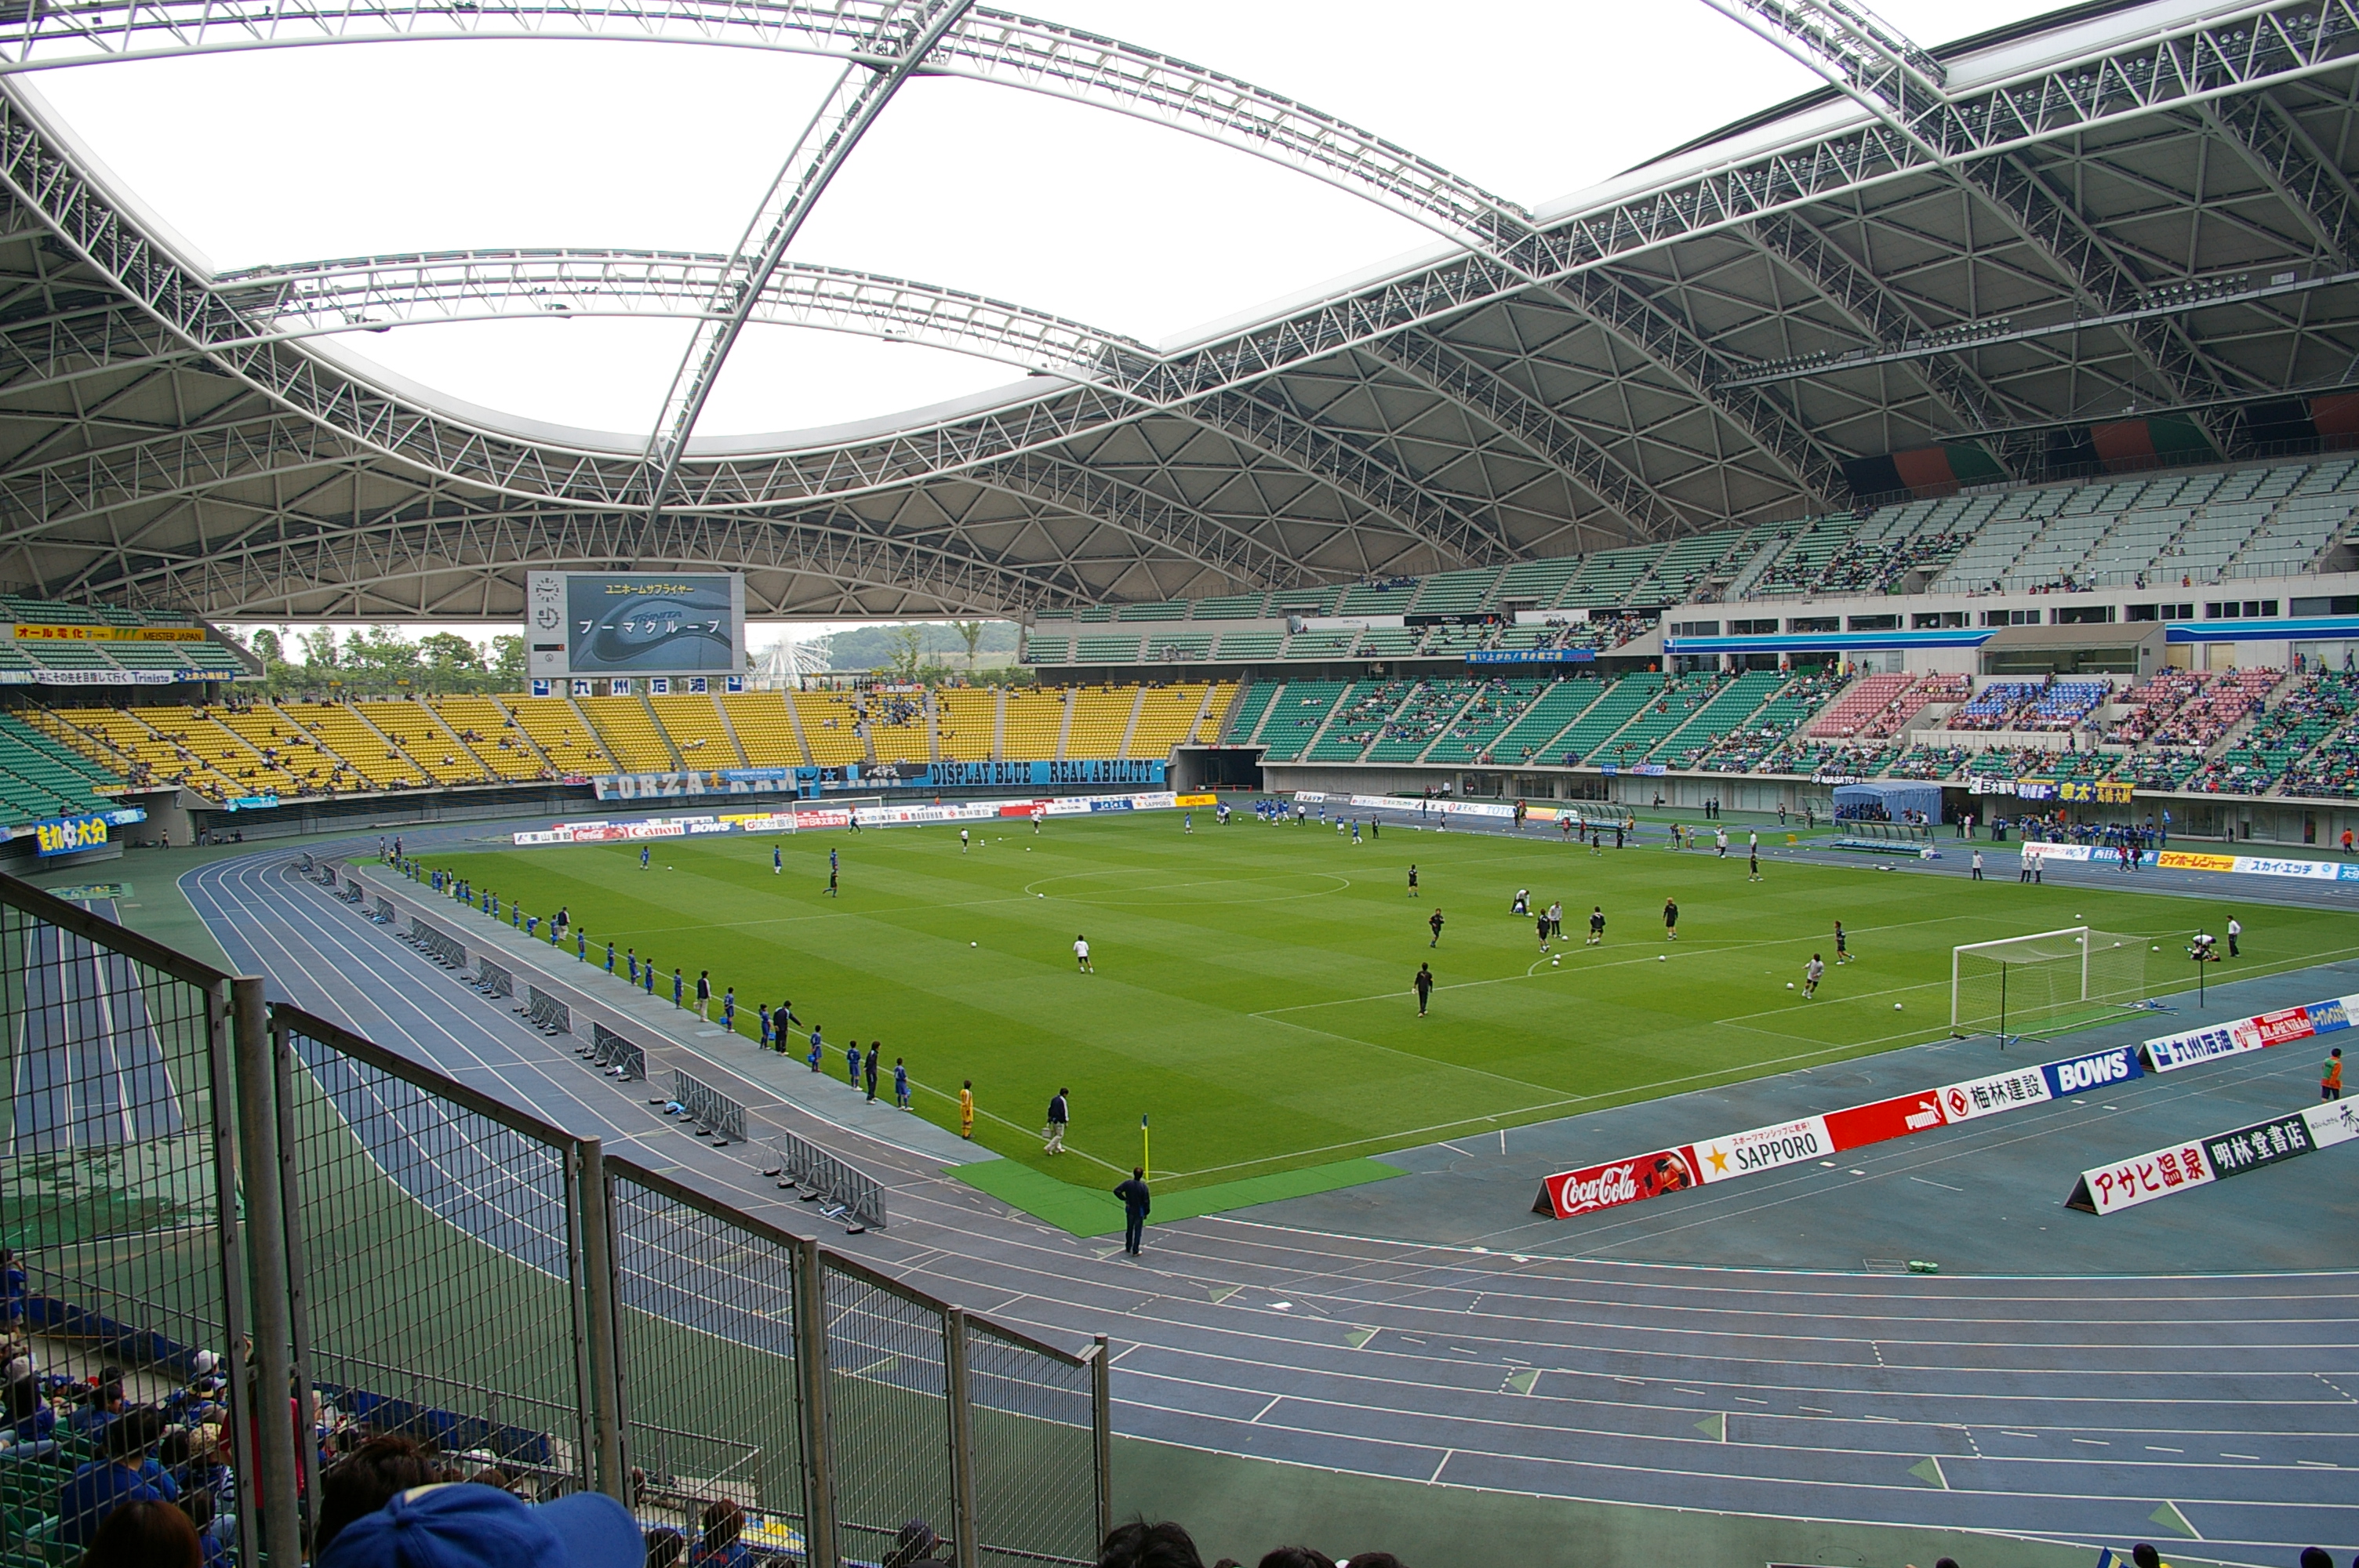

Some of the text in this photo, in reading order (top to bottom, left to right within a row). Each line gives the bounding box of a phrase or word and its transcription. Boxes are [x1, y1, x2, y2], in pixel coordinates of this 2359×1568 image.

[19, 627, 83, 639] オール電化
[144, 632, 202, 641] MEISTER JAPAN
[931, 761, 1031, 785] DISPLAY BLUE
[1049, 760, 1153, 783] REAL ABILITY
[1820, 775, 1856, 784] MASATO
[594, 772, 706, 800] FORZA
[174, 793, 184, 808] 2
[1486, 806, 1514, 817] TOTO
[632, 825, 682, 837] Canon
[690, 822, 731, 833] BOWS
[2172, 1029, 2235, 1062] 九州石油
[2056, 1051, 2128, 1092] BOWS
[1970, 1074, 2045, 1110] 梅林建設
[1735, 1132, 1818, 1171] SAPPORO
[2210, 1120, 2306, 1170] 明林堂書店
[1561, 1162, 1640, 1214] Coca-Cola
[2094, 1148, 2205, 1206] アサヒ温泉
